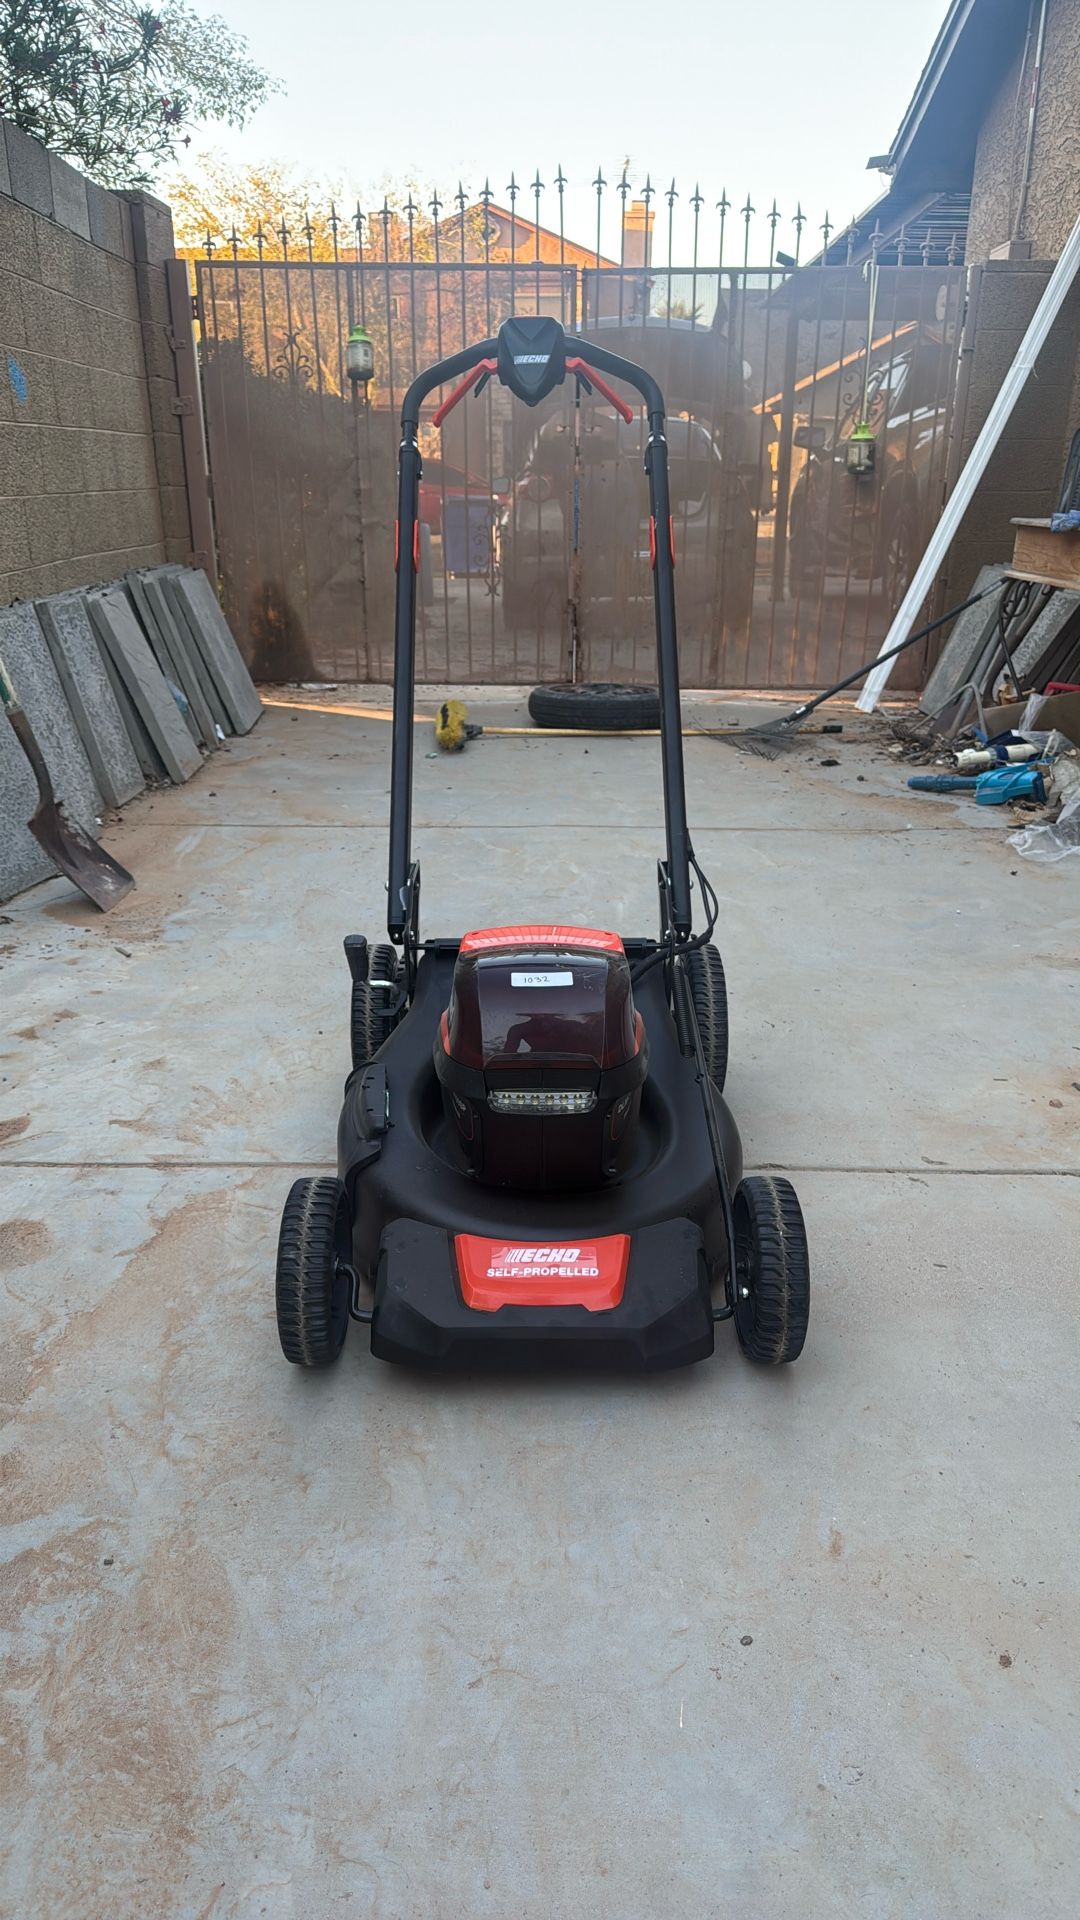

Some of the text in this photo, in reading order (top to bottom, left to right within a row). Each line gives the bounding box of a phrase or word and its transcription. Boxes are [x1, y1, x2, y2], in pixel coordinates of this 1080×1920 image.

[521, 354, 551, 364] ECHO
[523, 975, 550, 984] 1032
[519, 1248, 581, 1263] ECHO
[486, 1267, 599, 1277] SELF-PROPELLED
